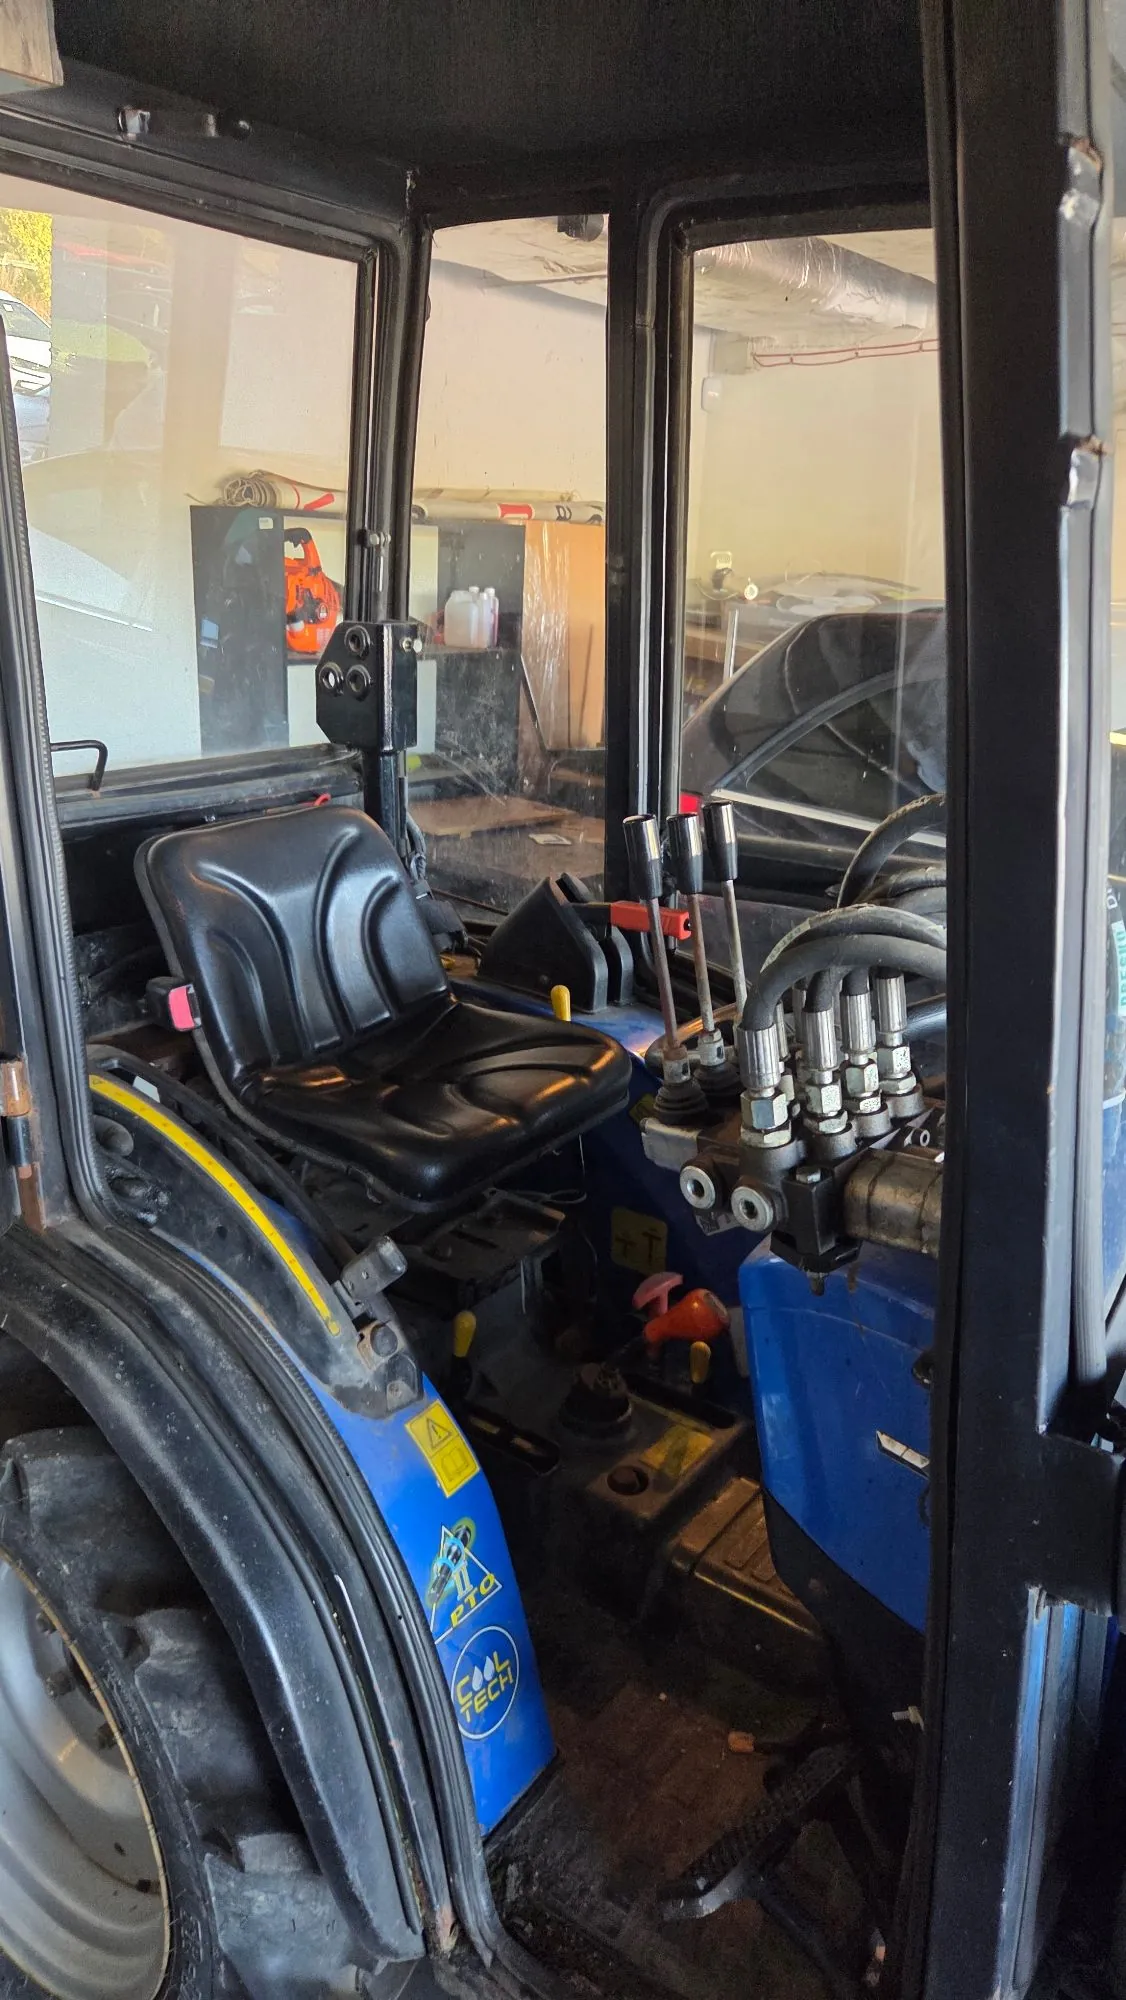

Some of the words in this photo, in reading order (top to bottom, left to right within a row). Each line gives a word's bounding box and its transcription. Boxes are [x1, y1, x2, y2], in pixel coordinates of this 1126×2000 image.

[450, 1573, 496, 1628] PTO
[455, 1650, 510, 1706] COOL
[459, 1665, 515, 1723] TECH
